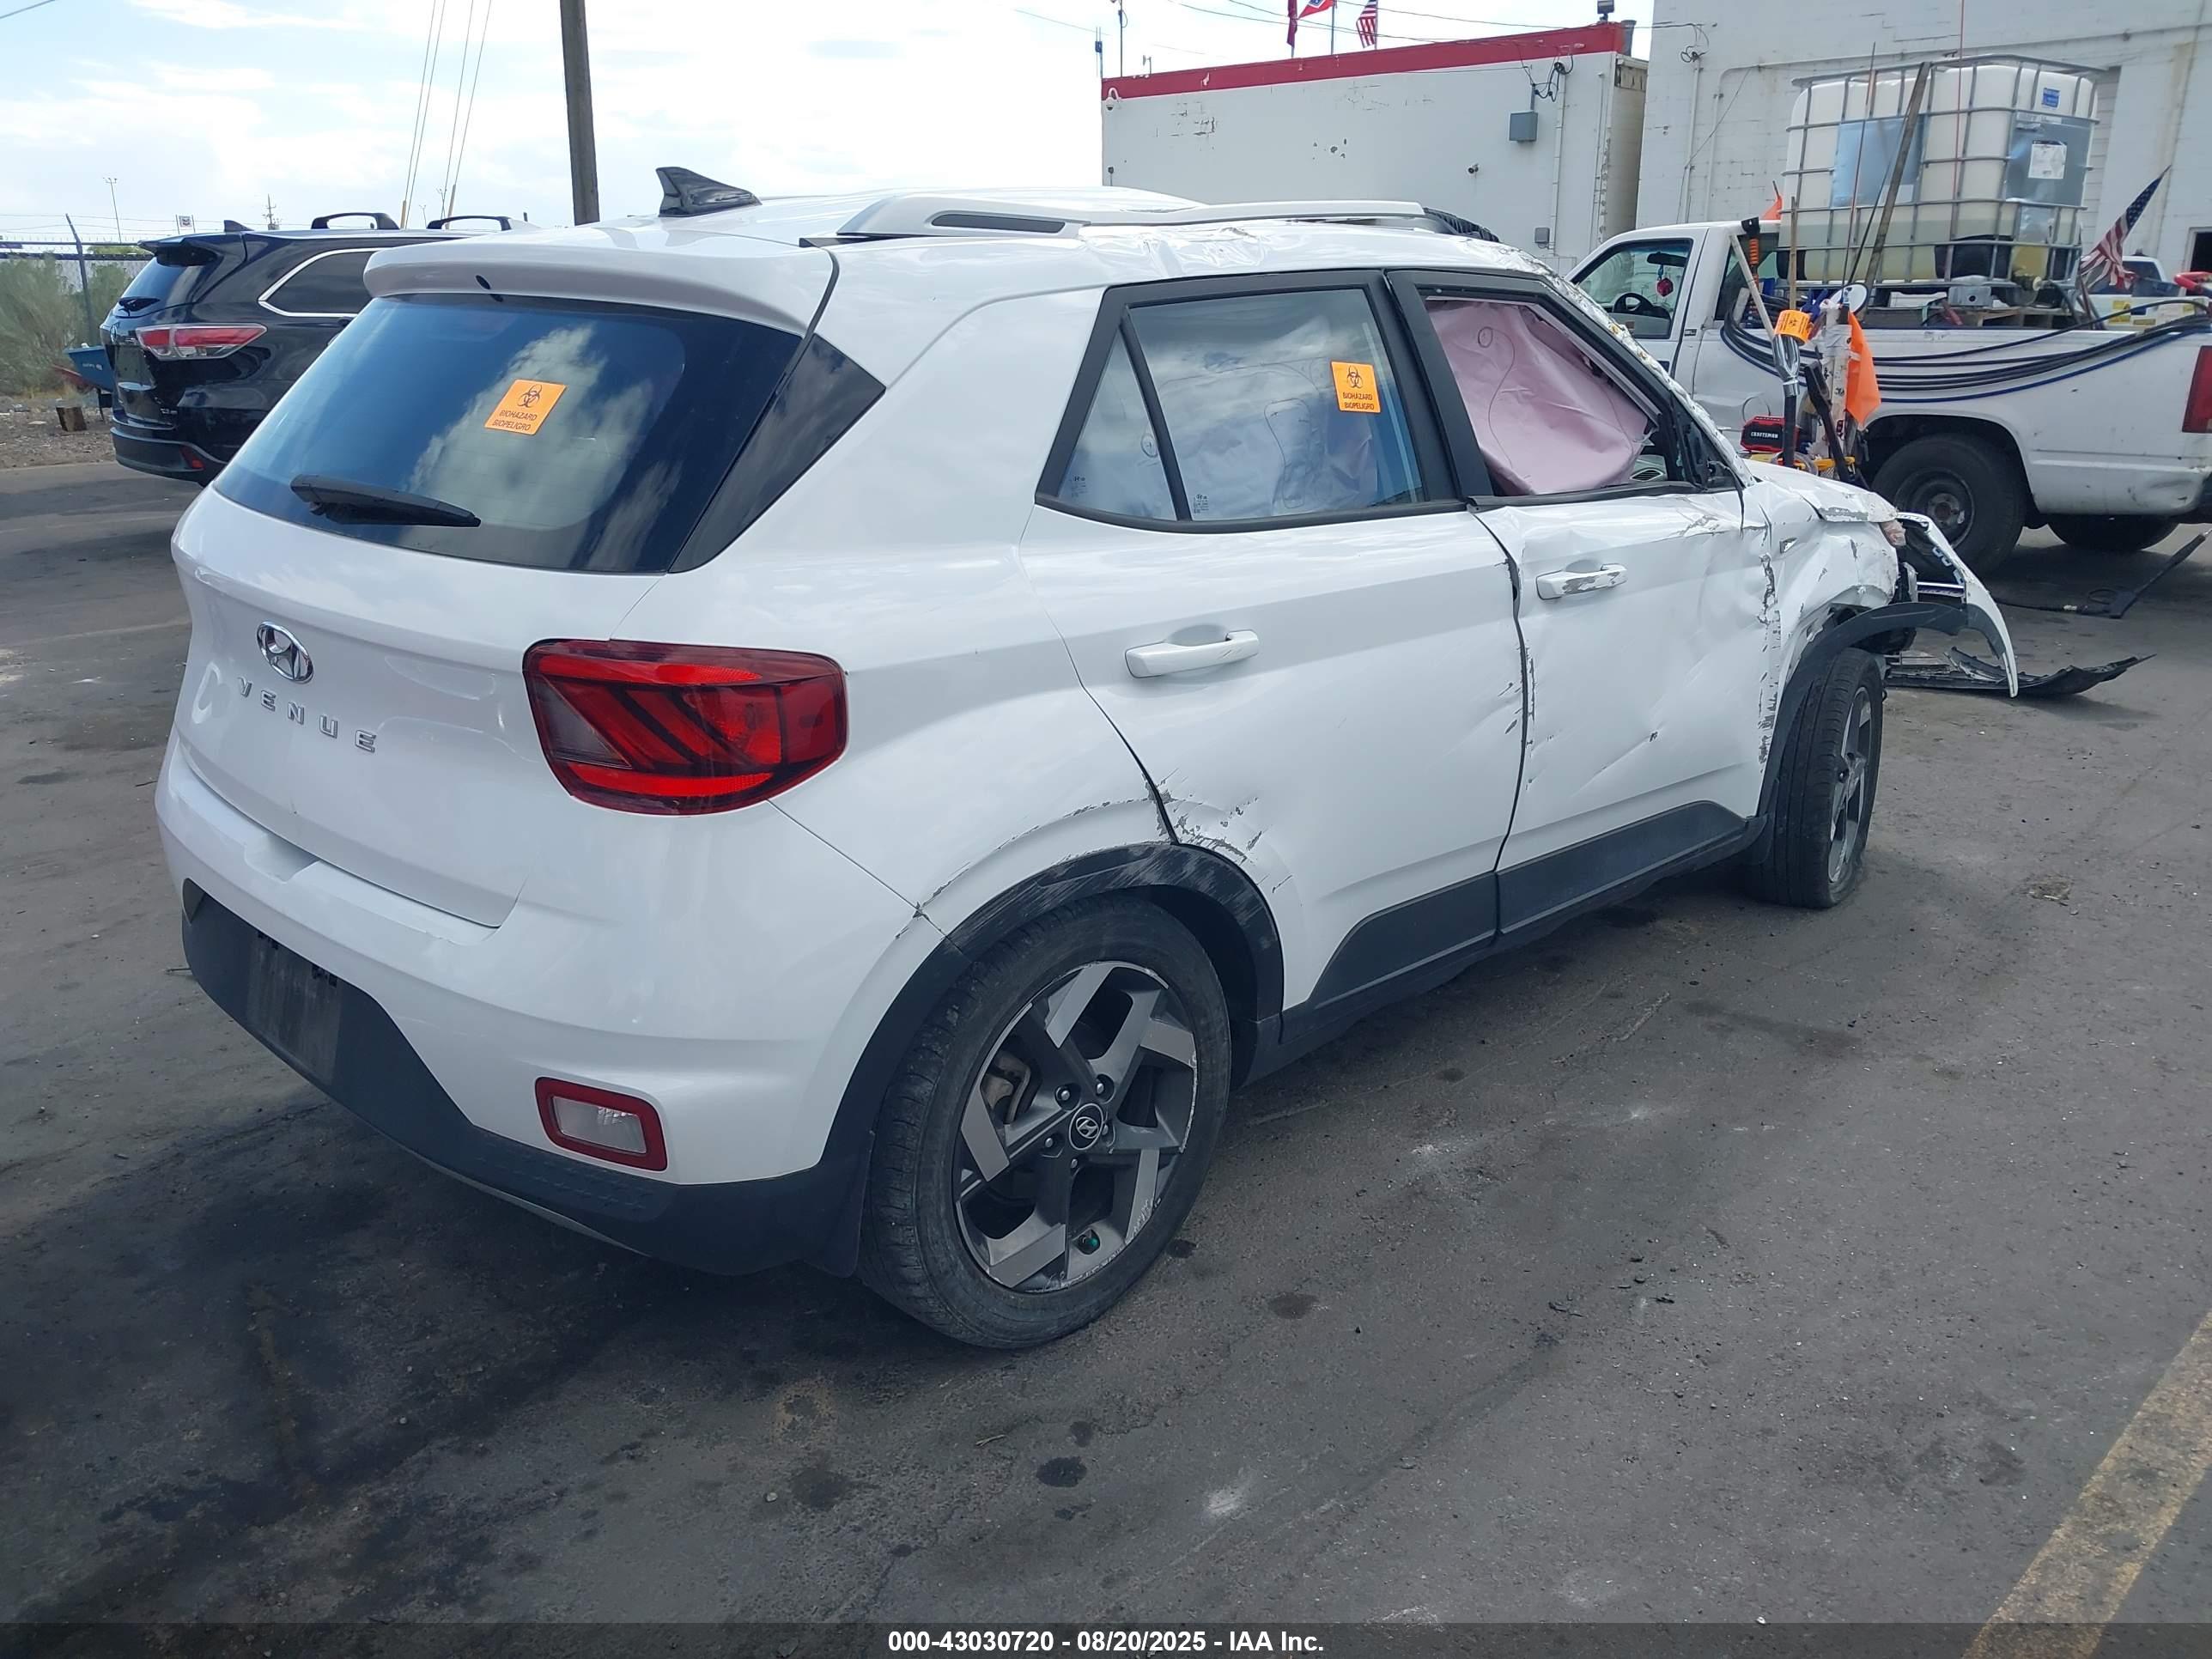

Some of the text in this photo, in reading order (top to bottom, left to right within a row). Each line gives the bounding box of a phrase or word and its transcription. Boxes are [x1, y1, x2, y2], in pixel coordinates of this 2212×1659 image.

[1342, 392, 1373, 401] BIOHAZARD
[1344, 402, 1375, 410] BIOPELIGRO
[499, 410, 538, 422] BIOHAZARD
[492, 419, 532, 431] BIOPELIGRO
[1750, 431, 1779, 440] CRAFTSMAN
[237, 675, 377, 754] VENUE
